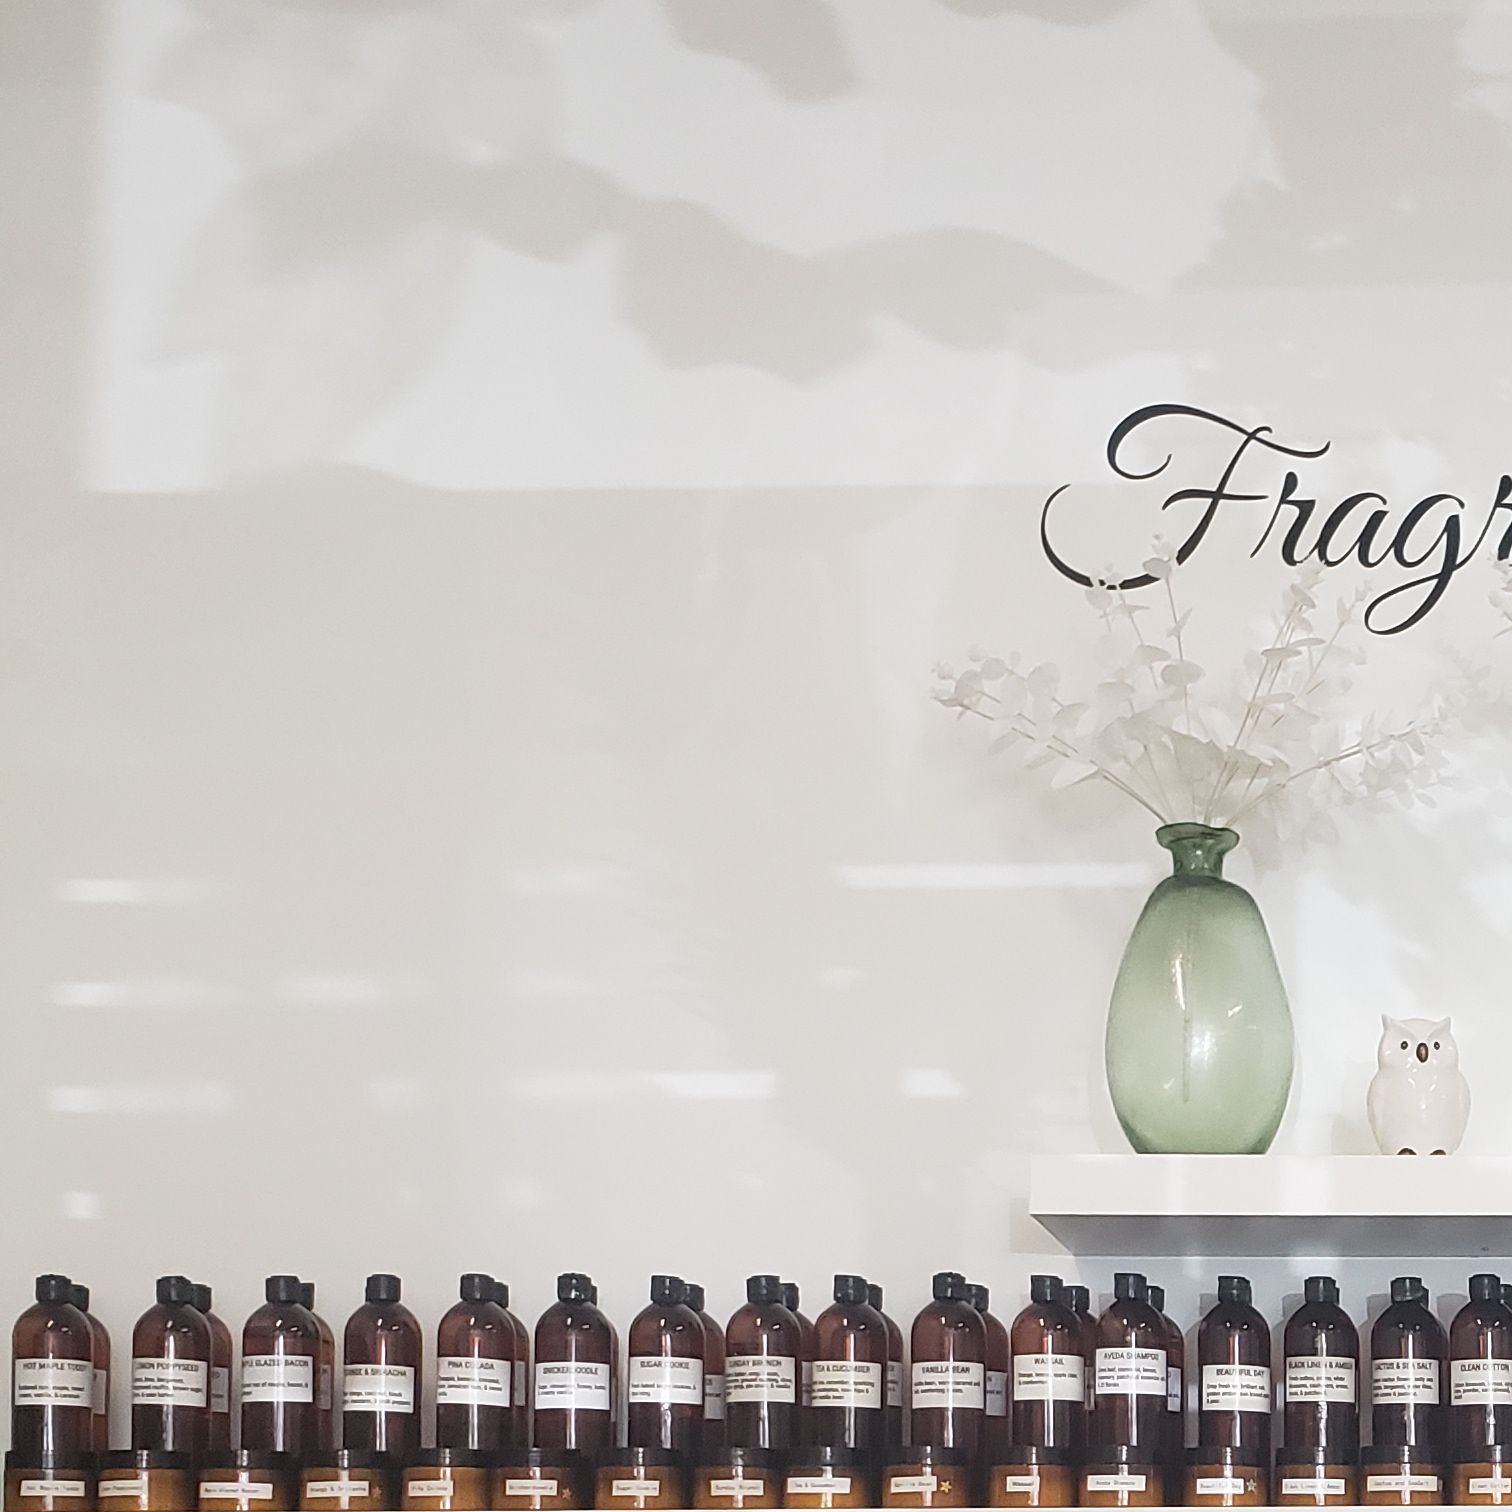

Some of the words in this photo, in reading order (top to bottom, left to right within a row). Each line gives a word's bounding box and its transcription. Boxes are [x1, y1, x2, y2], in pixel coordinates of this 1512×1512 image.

[1033, 1357, 1065, 1366] WAAIL
[1126, 1352, 1159, 1362] SAMPOO
[465, 1361, 496, 1371] CADA
[753, 1360, 783, 1369] BRNCH
[1482, 1364, 1510, 1374] CTTON
[542, 1366, 599, 1376] SNICKEROODLE
[1216, 1368, 1253, 1377] BEAUIFUL
